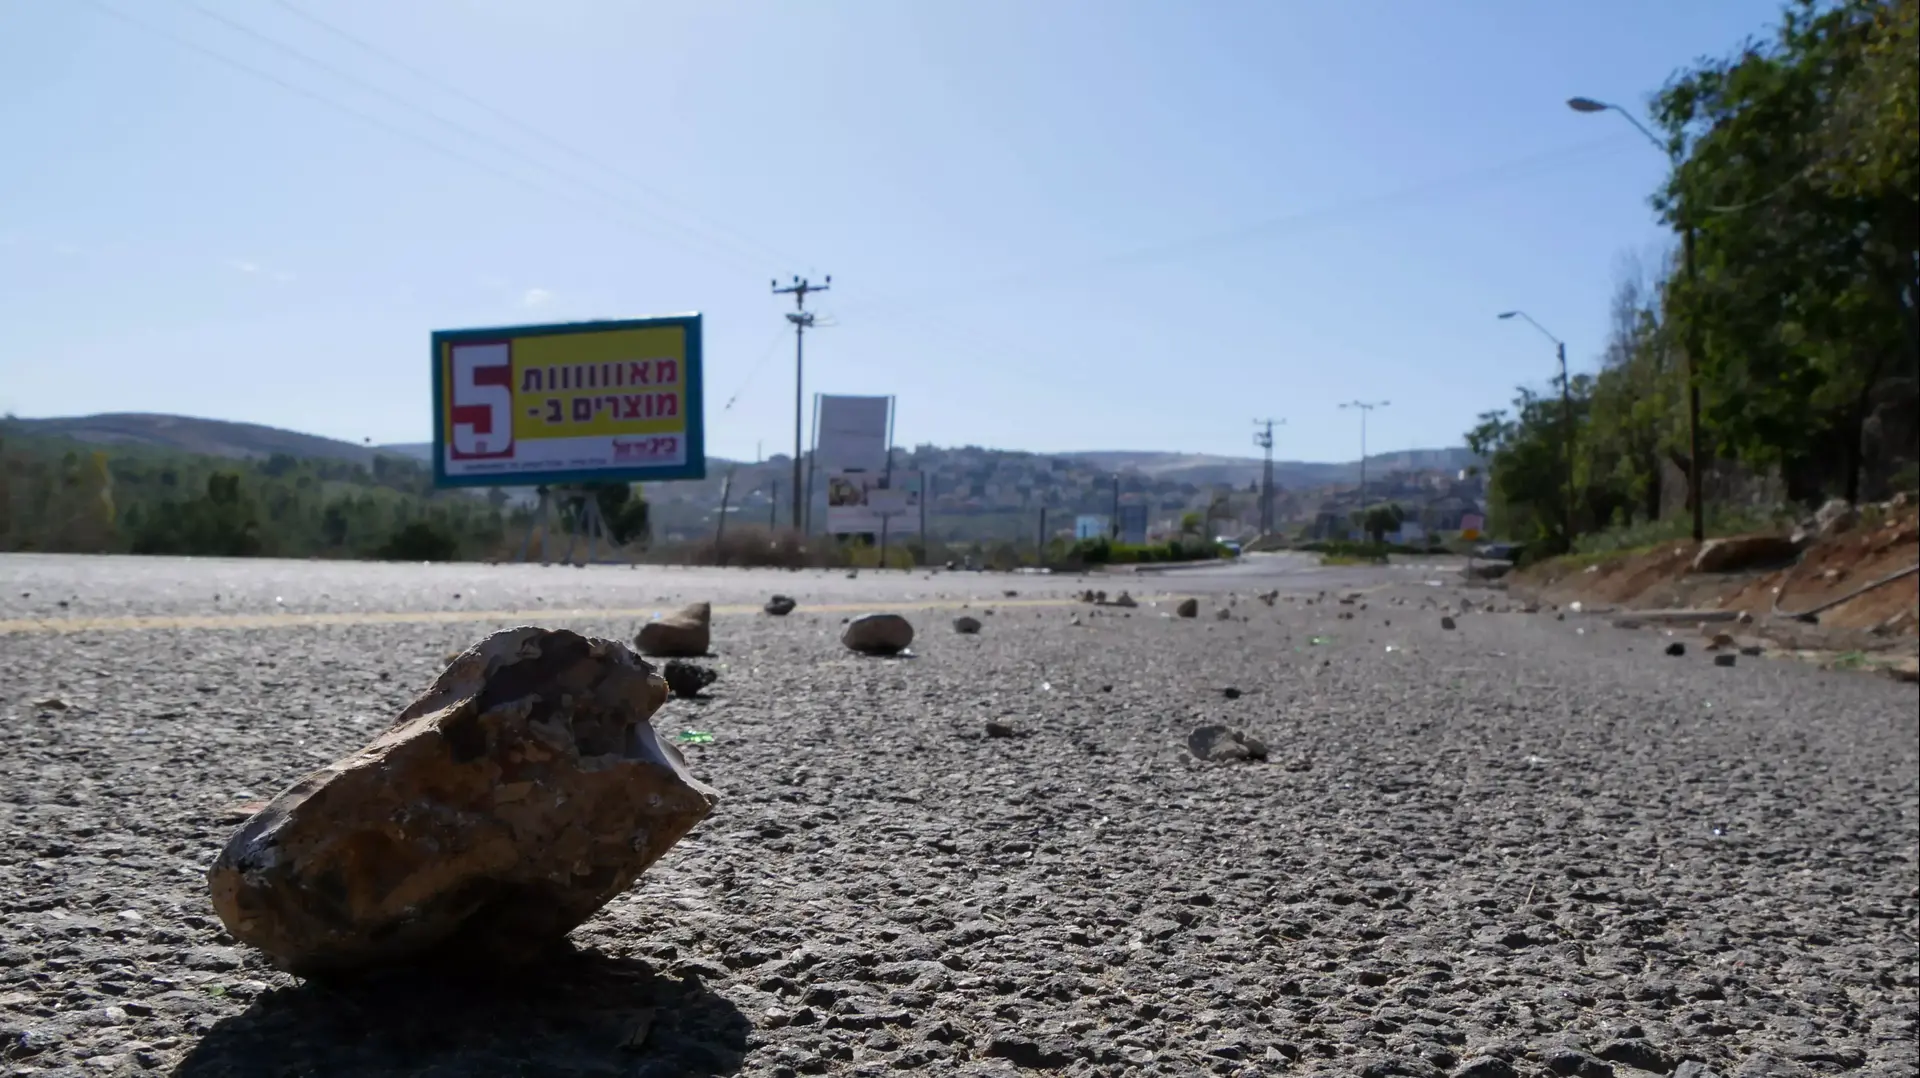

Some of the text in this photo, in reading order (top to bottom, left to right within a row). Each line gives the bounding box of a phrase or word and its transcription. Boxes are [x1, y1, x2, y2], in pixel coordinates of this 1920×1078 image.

[521, 360, 677, 392] מאוווווות
[452, 342, 512, 453] 5
[572, 392, 677, 422] מוצרים
